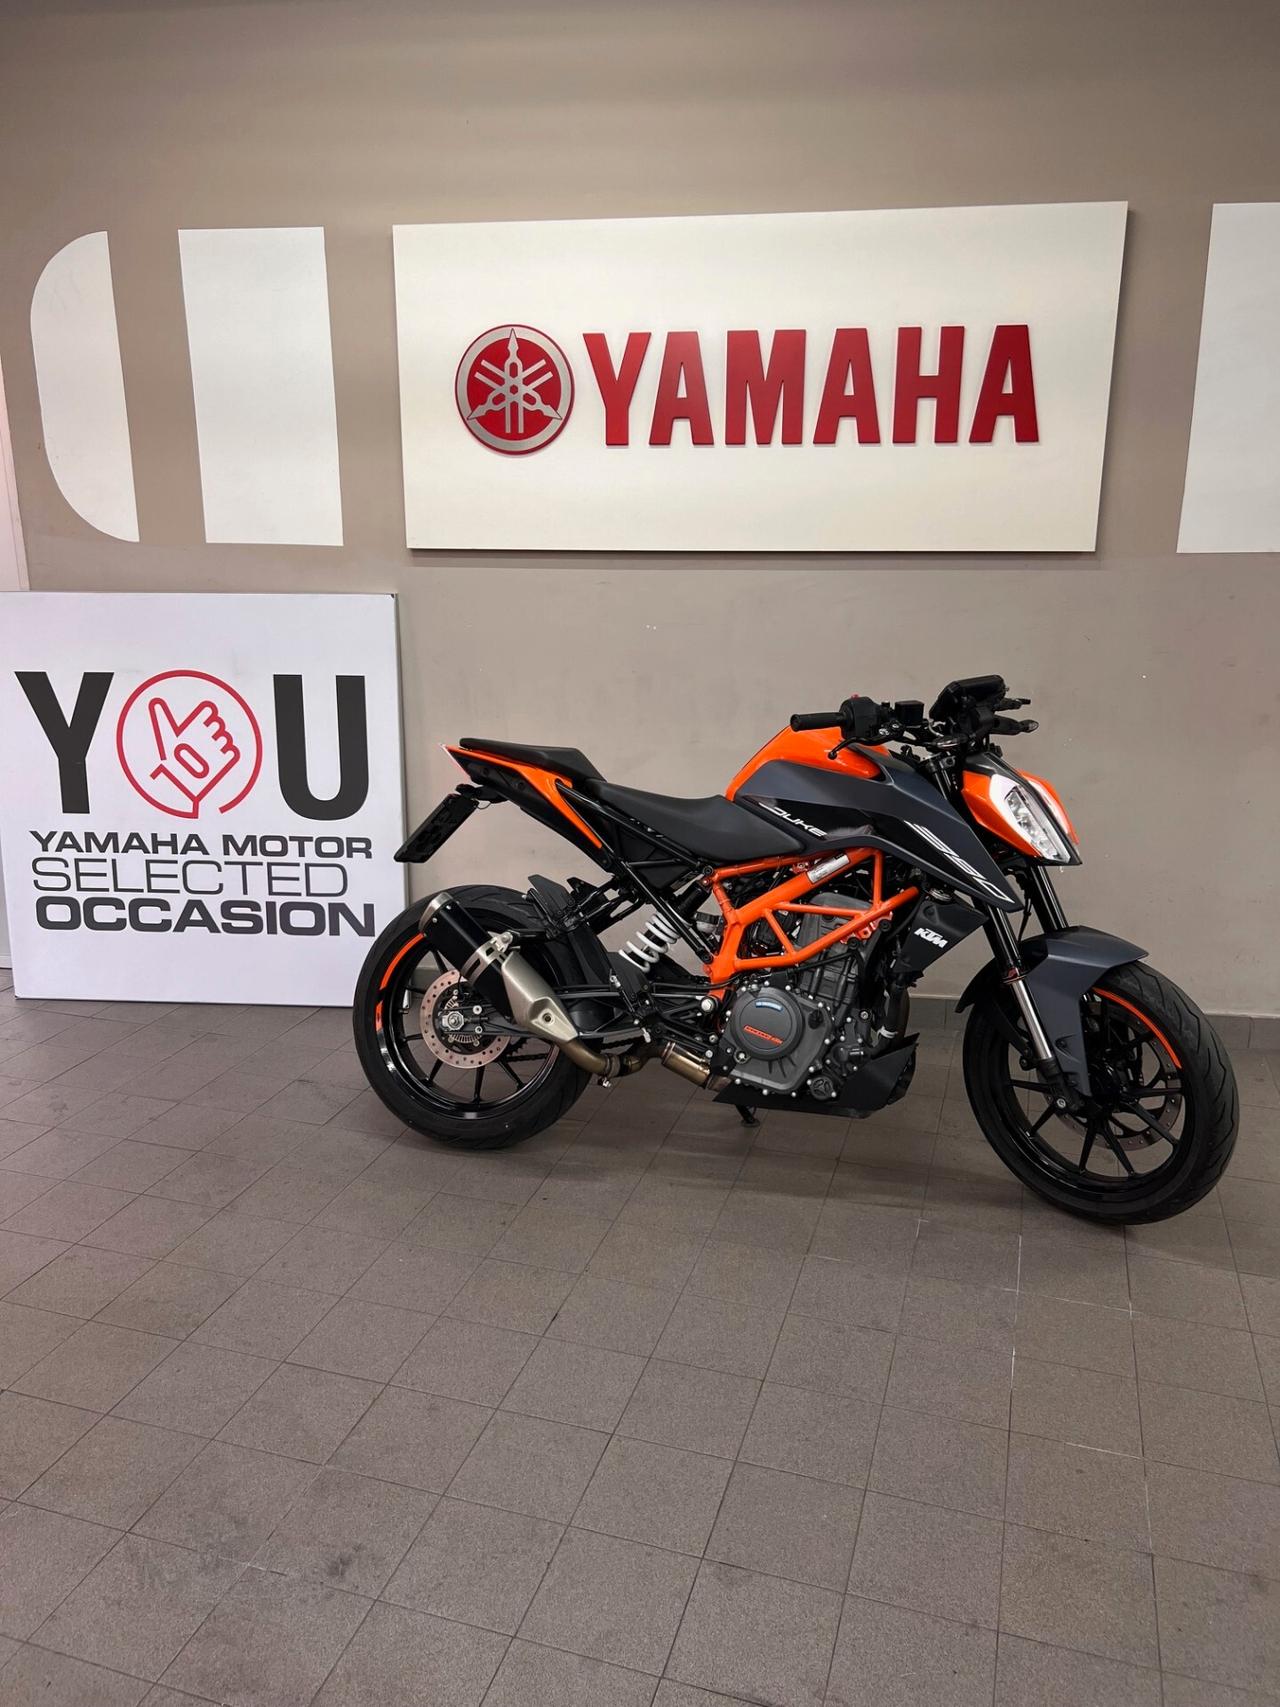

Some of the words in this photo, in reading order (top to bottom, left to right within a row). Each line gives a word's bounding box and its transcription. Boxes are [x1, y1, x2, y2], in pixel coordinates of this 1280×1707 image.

[582, 324, 1040, 447] YAMAHA
[759, 802, 828, 837] DUKE
[29, 830, 210, 856] YAMAHA
[222, 834, 373, 859] MOTOR
[903, 819, 1016, 904] 390
[31, 856, 349, 898] SELECTED
[35, 895, 377, 938] OCCASION
[913, 927, 949, 949] KTM
